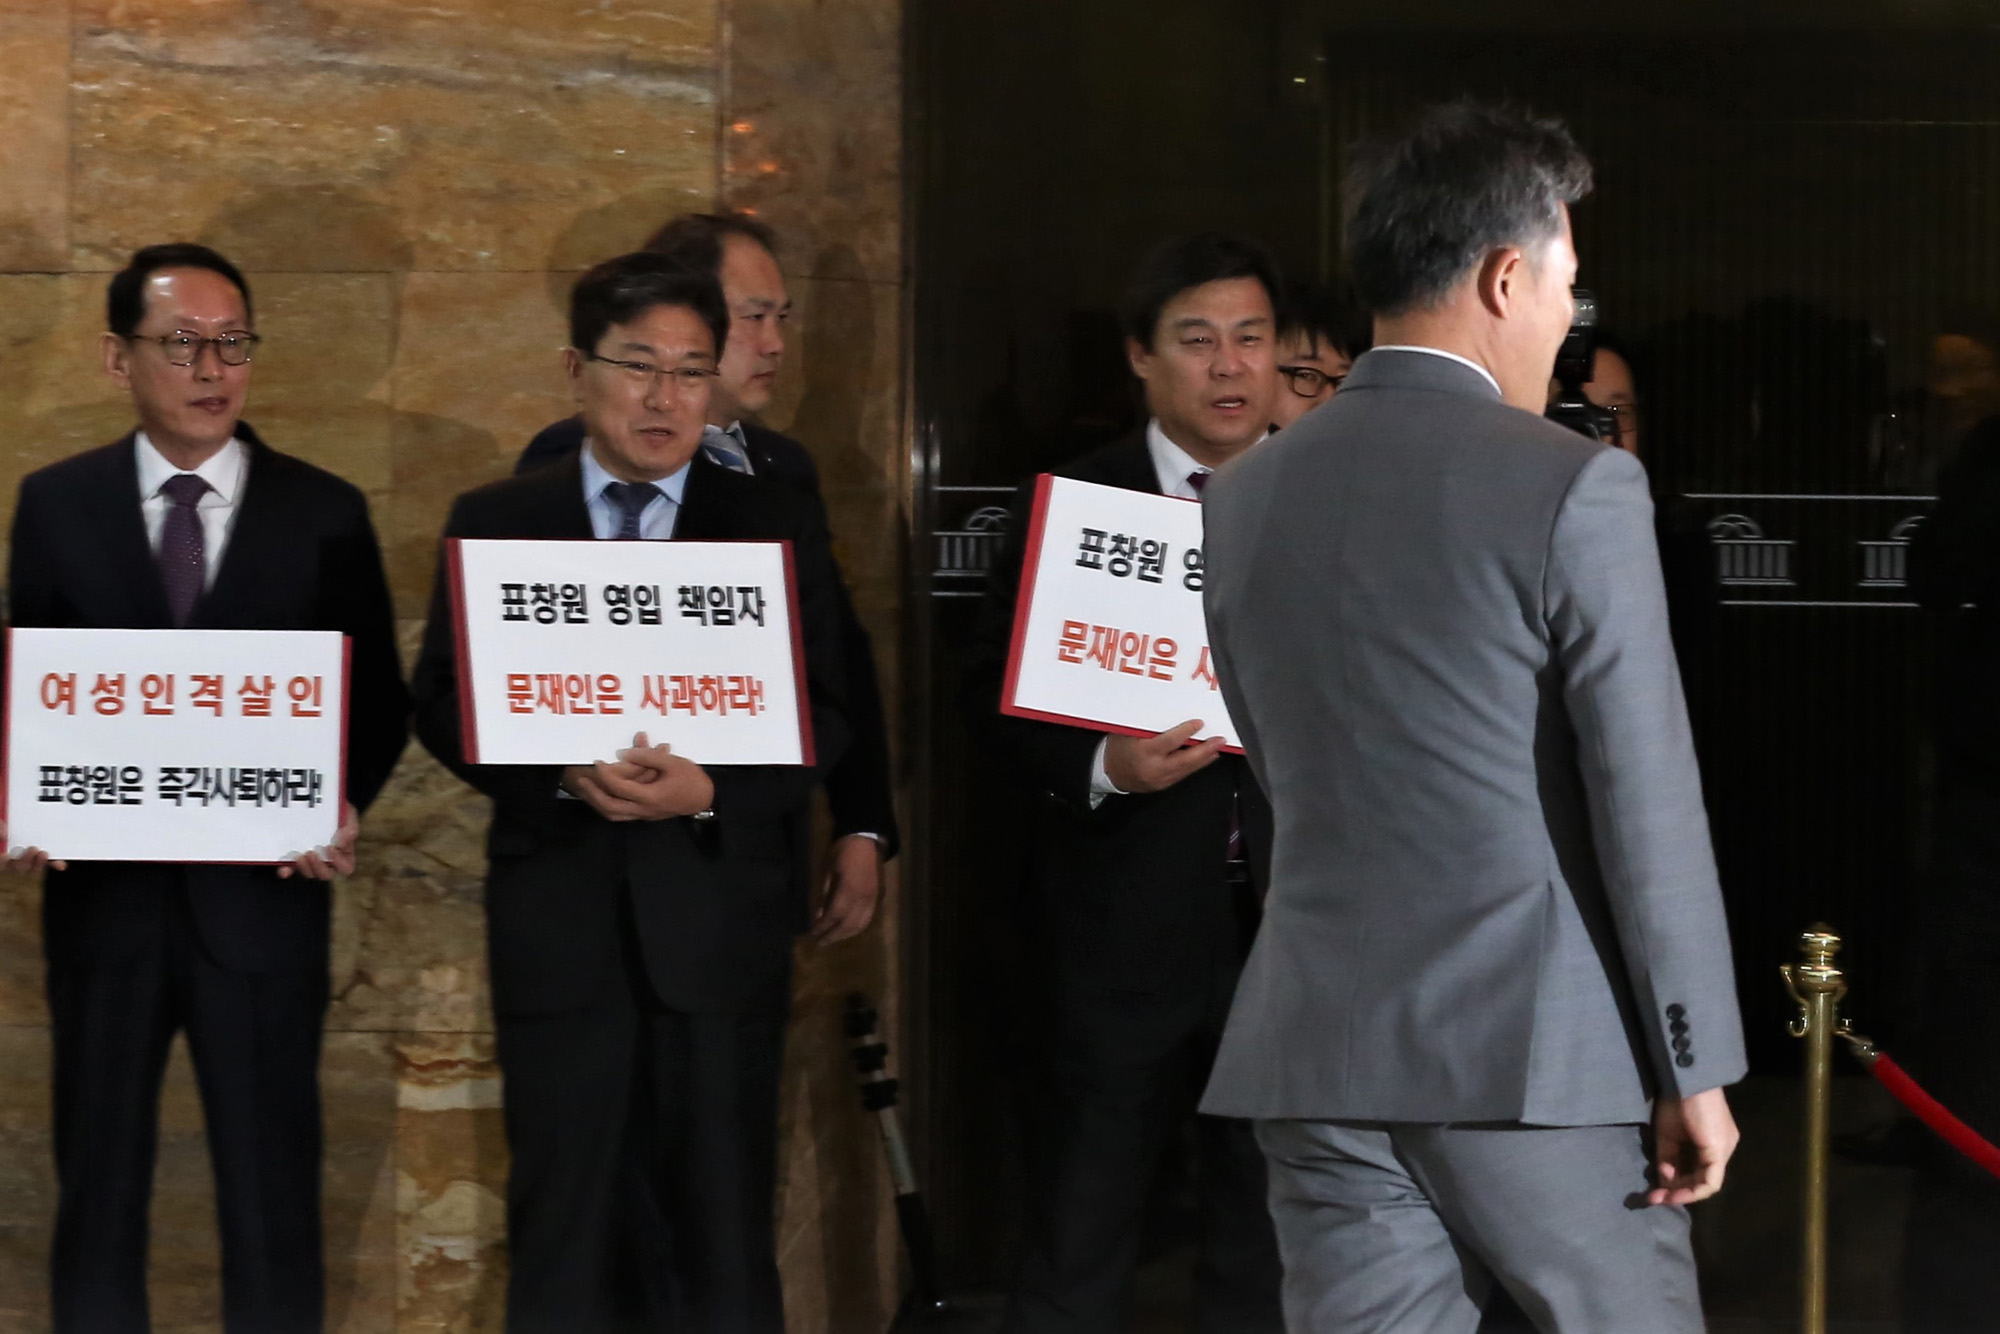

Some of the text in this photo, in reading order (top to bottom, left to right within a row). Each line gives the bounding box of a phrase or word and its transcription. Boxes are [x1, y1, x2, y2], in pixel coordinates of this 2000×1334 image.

[1075, 527, 1168, 584] 표창원
[500, 582, 766, 627] 표창원 영입 책임자
[1058, 619, 1178, 681] 문재인은
[506, 672, 765, 717] 문재인은 사과하라!
[36, 764, 323, 809] 표창원은 즉각사퇴하라!
